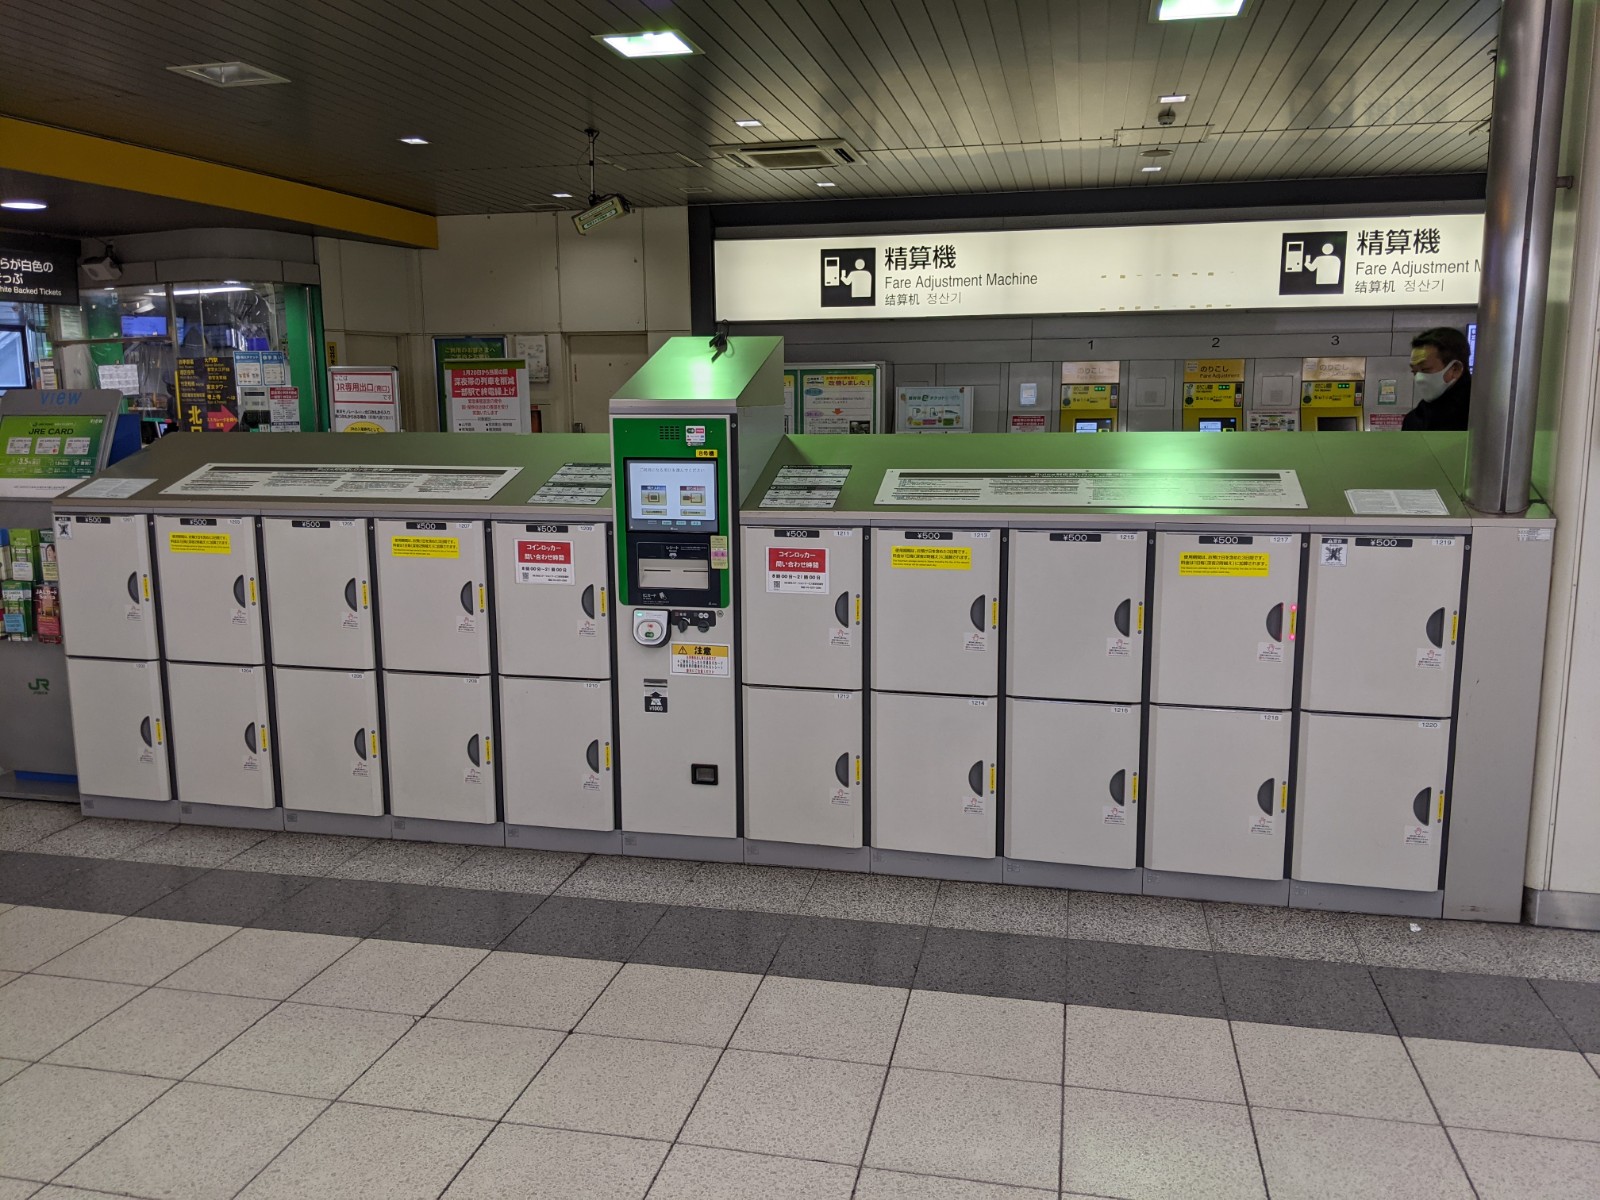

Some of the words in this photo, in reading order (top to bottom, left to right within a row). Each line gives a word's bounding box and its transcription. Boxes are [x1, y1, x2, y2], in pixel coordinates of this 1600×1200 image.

[1356, 228, 1441, 256] 精算機
[884, 245, 957, 271] 精算機
[1355, 262, 1387, 276] Fare
[1391, 260, 1470, 277] Adjustment
[885, 276, 912, 290] Fare
[915, 274, 983, 290] Adjustment
[986, 271, 1038, 286] Machine
[1404, 279, 1445, 292] 정산기
[13, 286, 39, 295] Backed
[40, 287, 62, 297] Tickets
[1354, 280, 1396, 294] 结算机
[884, 293, 921, 306] 结算机
[926, 292, 962, 305] 정산기
[1087, 340, 1094, 350] 1
[1211, 337, 1221, 348] 2
[1330, 335, 1340, 346] 3
[1200, 365, 1229, 373] のりこし
[416, 522, 436, 530] ¥500
[537, 525, 558, 533] ¥500
[786, 530, 808, 538] ¥500
[917, 532, 940, 540] ¥500
[1063, 534, 1088, 542] ¥500
[1213, 536, 1239, 544] ¥500
[1370, 539, 1398, 547] ¥500
[524, 553, 565, 561] 問い合わせ時間
[778, 551, 816, 559] コインロッカー
[775, 560, 820, 569] 問い合わせ時間
[694, 646, 712, 656] 注意
